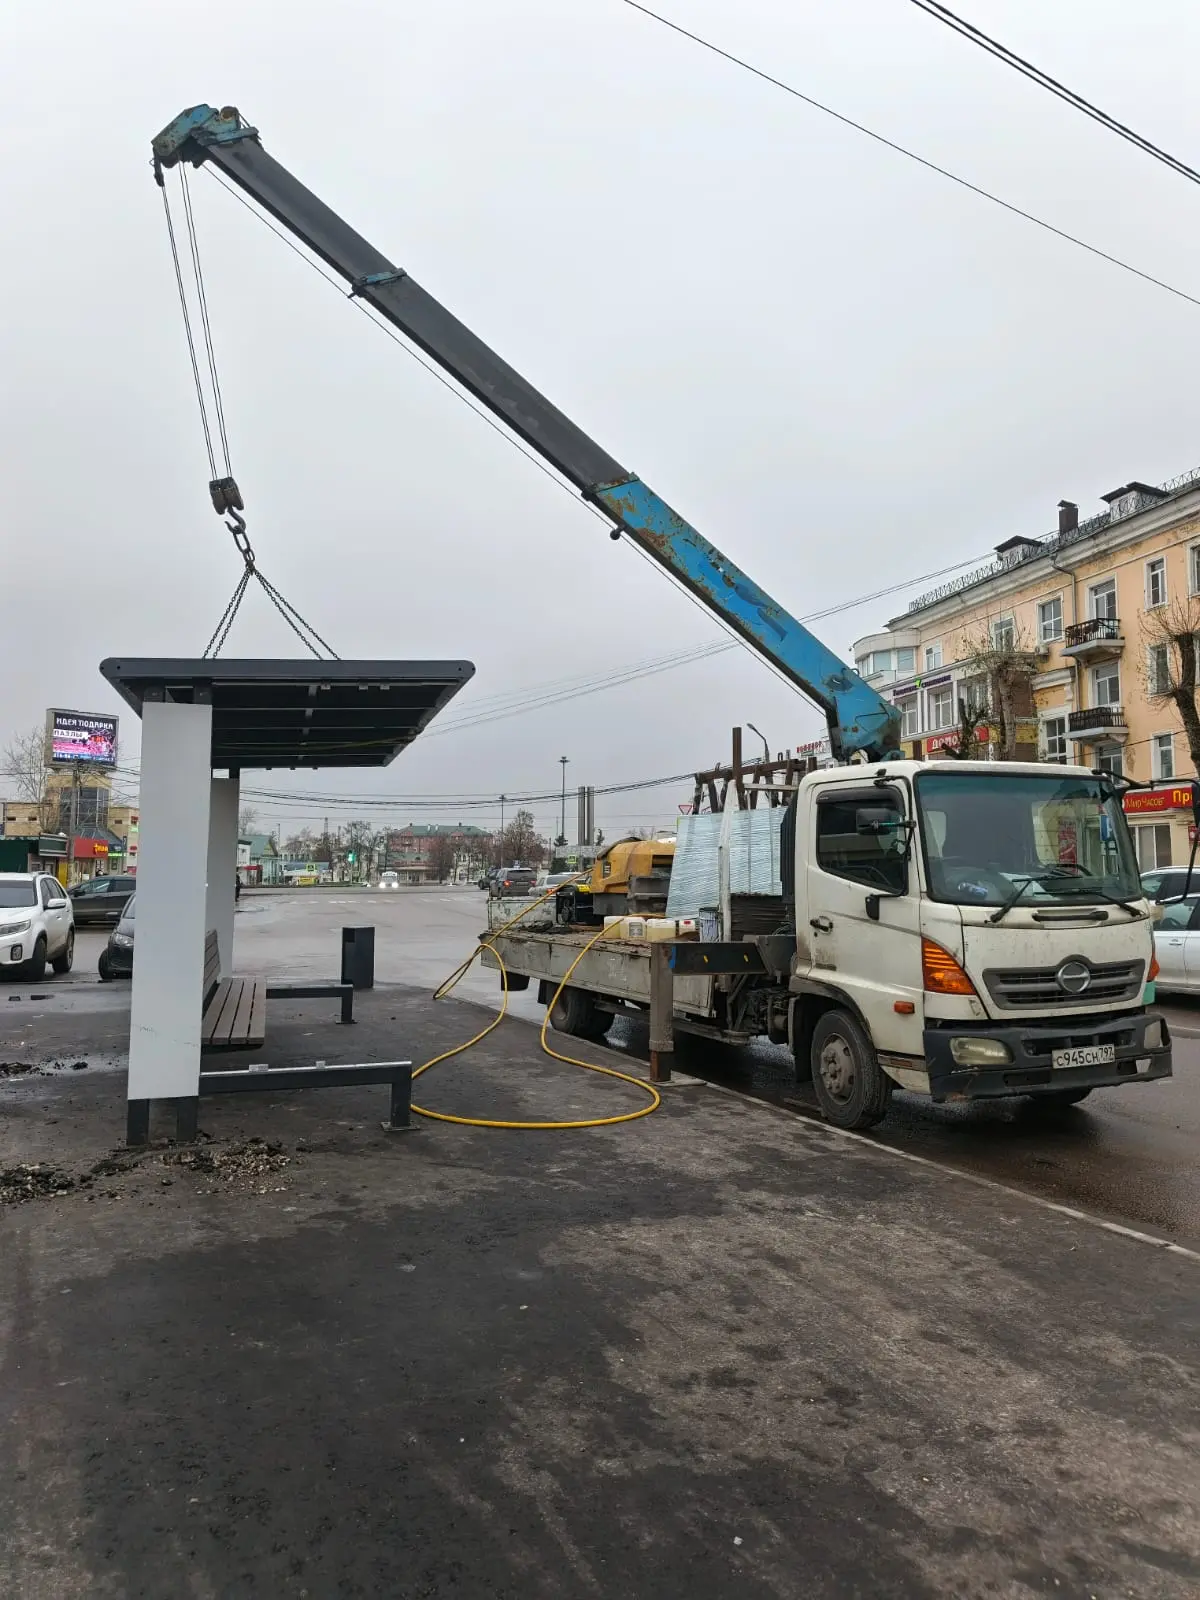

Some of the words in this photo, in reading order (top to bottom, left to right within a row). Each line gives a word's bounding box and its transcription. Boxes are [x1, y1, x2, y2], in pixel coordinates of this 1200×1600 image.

[56, 718, 77, 726] ИДЕЯ
[78, 719, 114, 730] ПОДАРКА
[54, 729, 83, 738] ПАЗЛЫ
[1172, 789, 1193, 806] Пр
